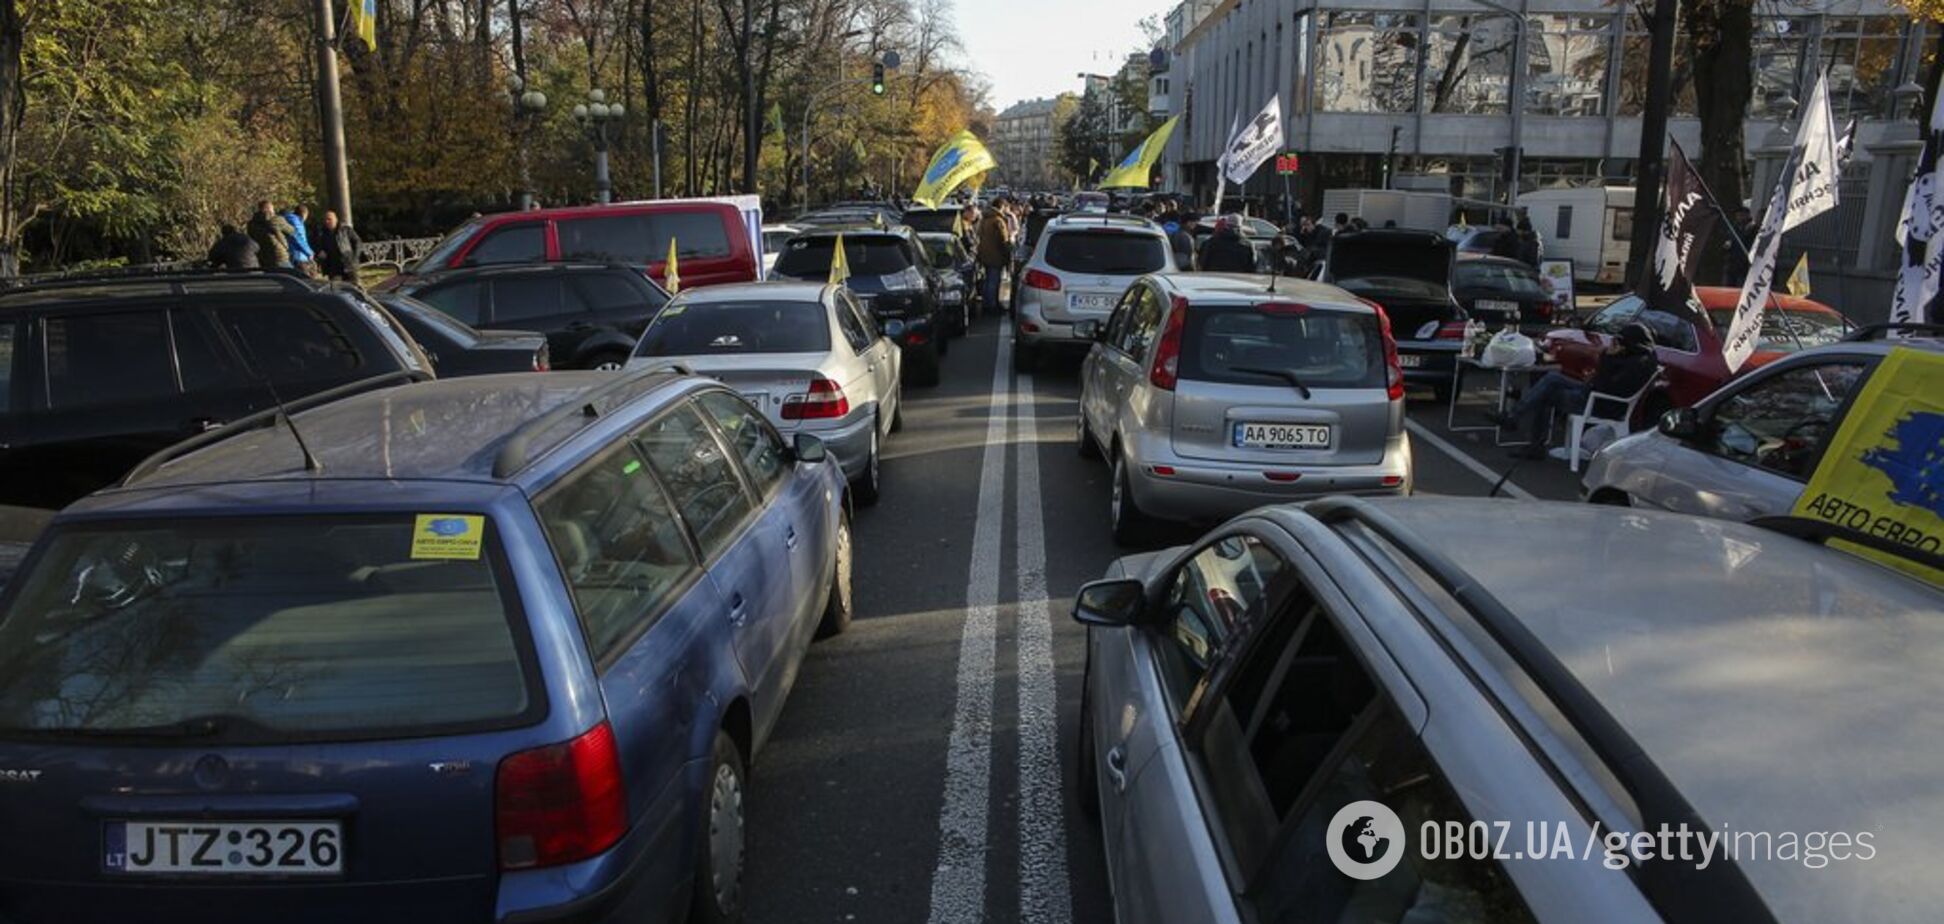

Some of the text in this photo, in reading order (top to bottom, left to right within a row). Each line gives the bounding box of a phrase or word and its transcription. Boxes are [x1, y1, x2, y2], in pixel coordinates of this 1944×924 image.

[1245, 426, 1328, 443] AA 9065 TO
[1805, 492, 1871, 530] АВТО
[106, 854, 125, 867] LT
